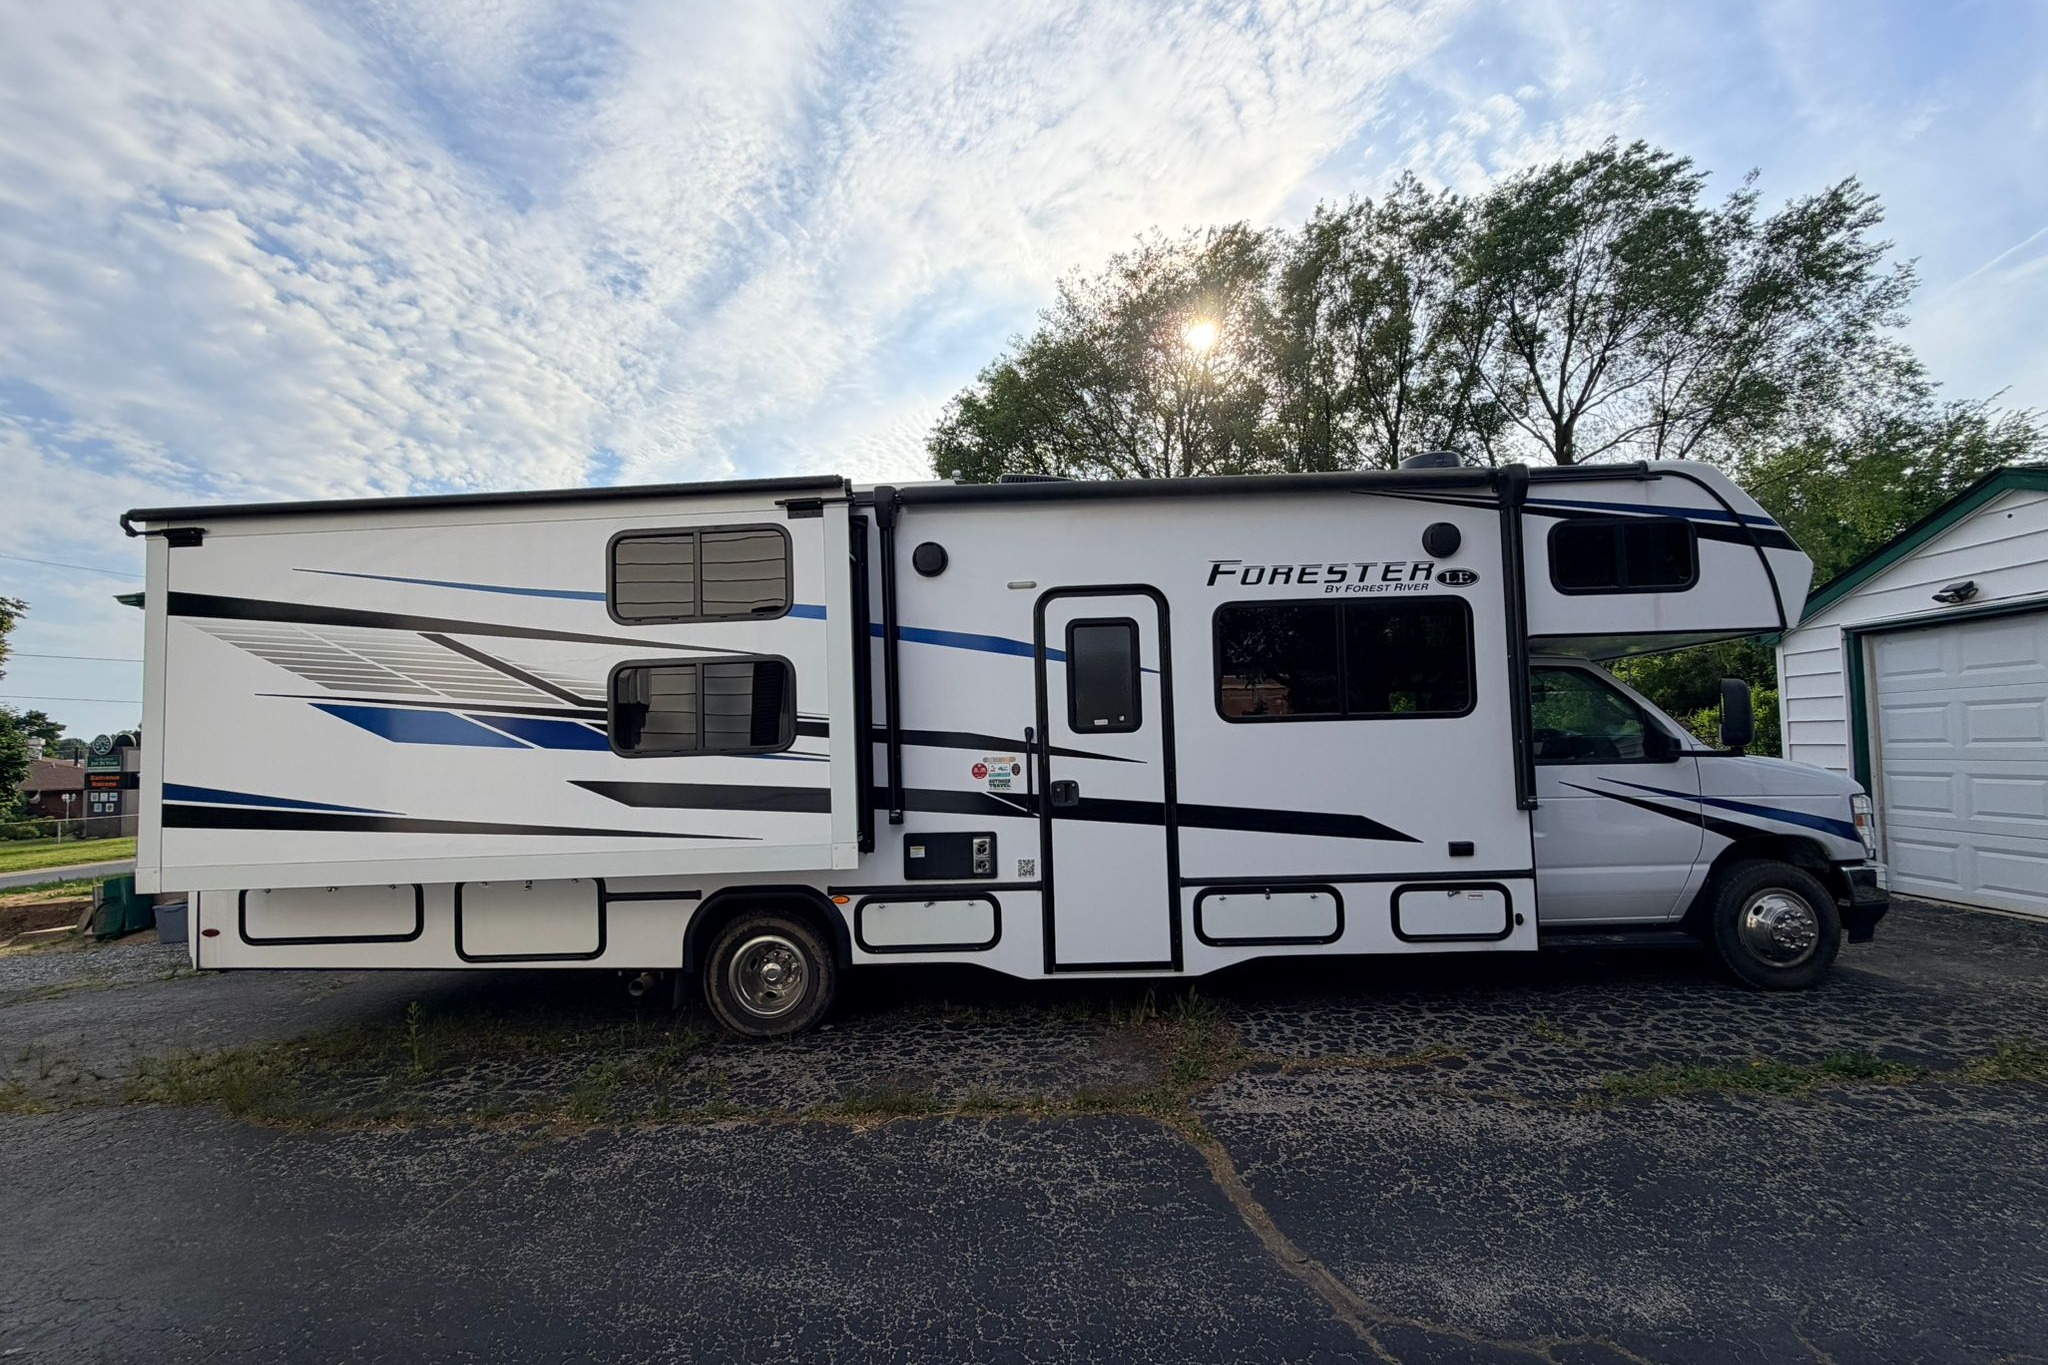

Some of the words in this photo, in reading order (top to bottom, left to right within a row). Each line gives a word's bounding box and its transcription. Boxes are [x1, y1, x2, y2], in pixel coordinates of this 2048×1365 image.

[1206, 559, 1435, 587] FORESTER
[1443, 571, 1472, 584] LE
[1344, 583, 1391, 593] FOREST
[1393, 582, 1429, 592] RIVER
